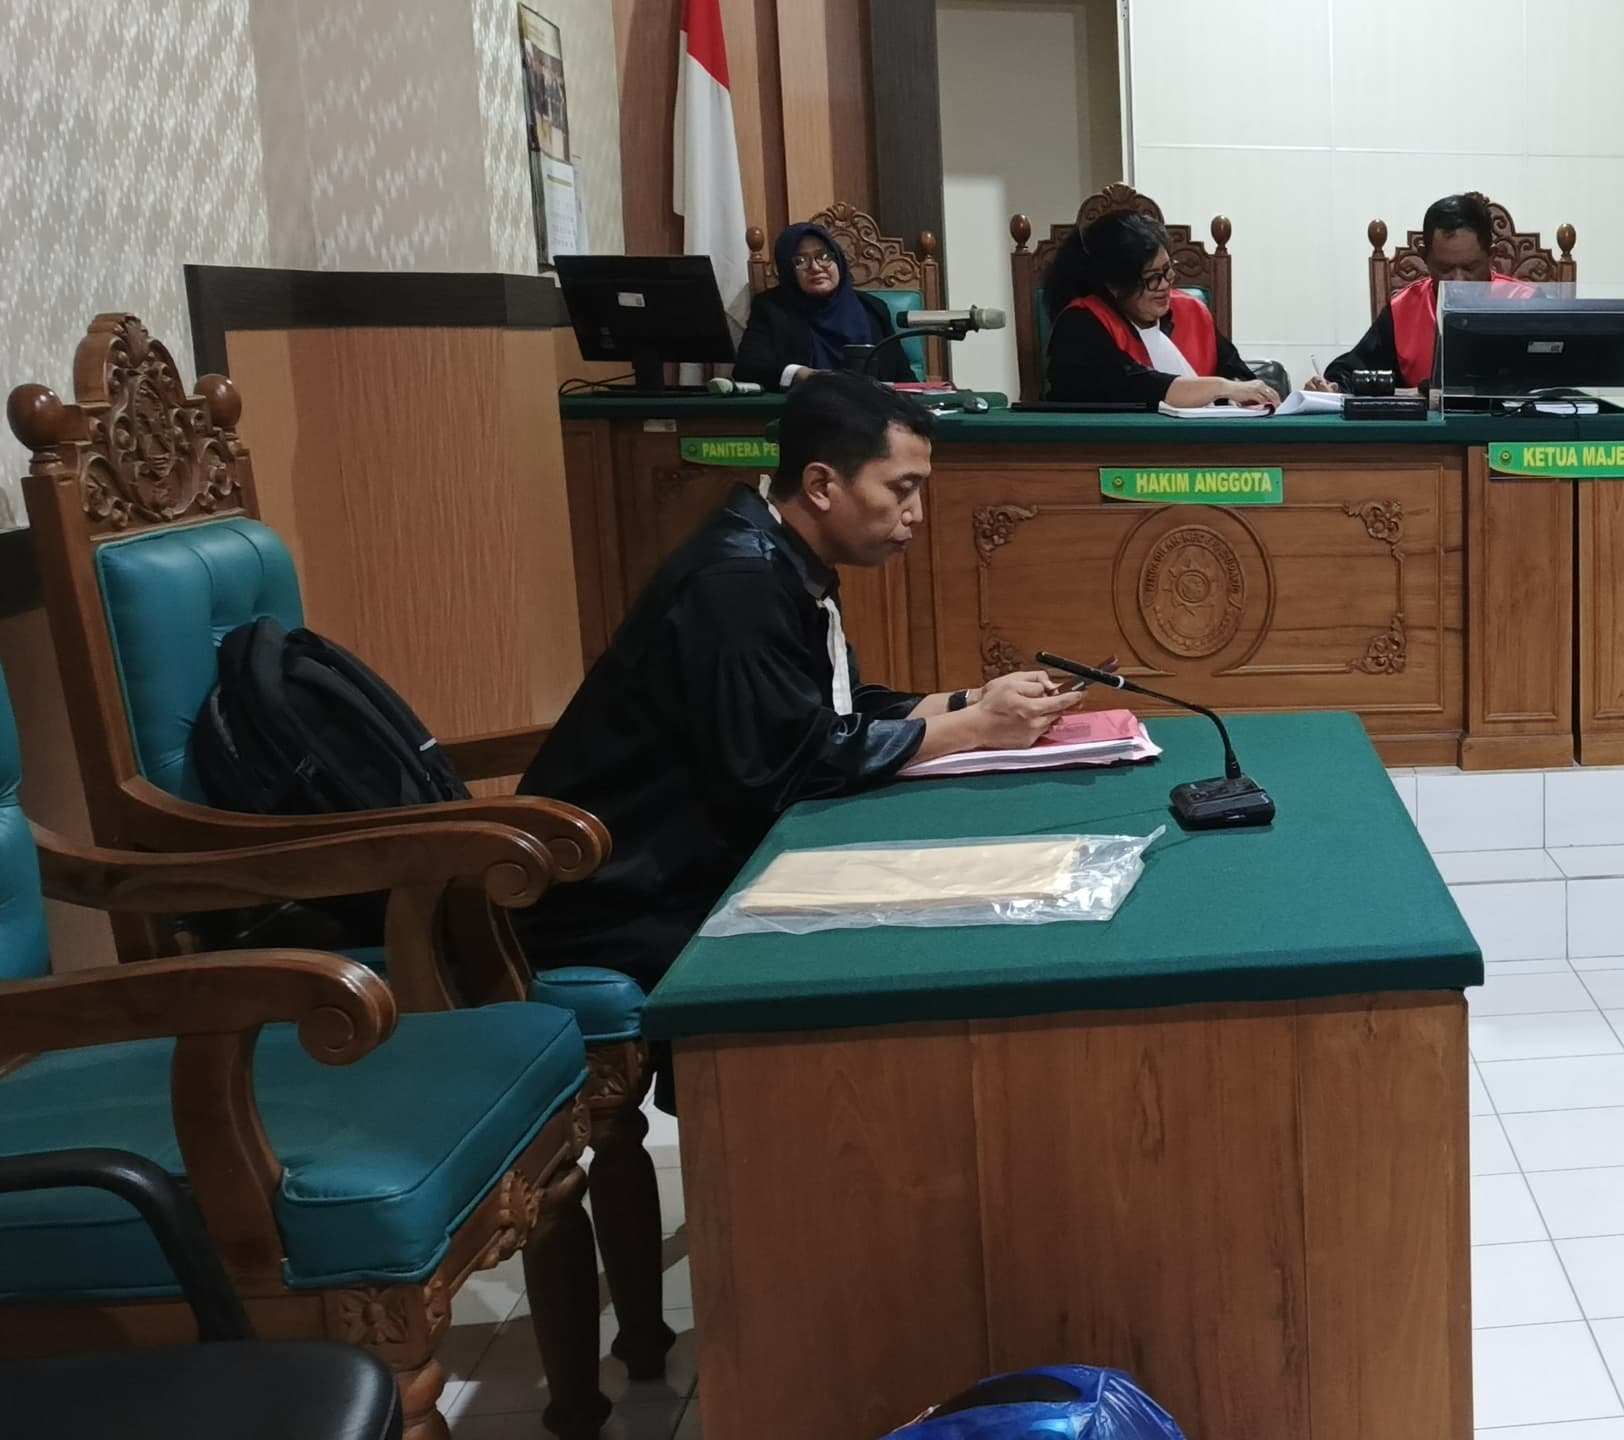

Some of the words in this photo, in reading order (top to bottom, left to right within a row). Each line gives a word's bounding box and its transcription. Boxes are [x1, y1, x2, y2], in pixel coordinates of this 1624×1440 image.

[702, 442, 760, 457] PANITERA
[762, 442, 779, 457] PE
[1523, 446, 1578, 467] KETUA
[1136, 472, 1190, 493] HAKIM
[1194, 471, 1273, 493] ANGGOTA
